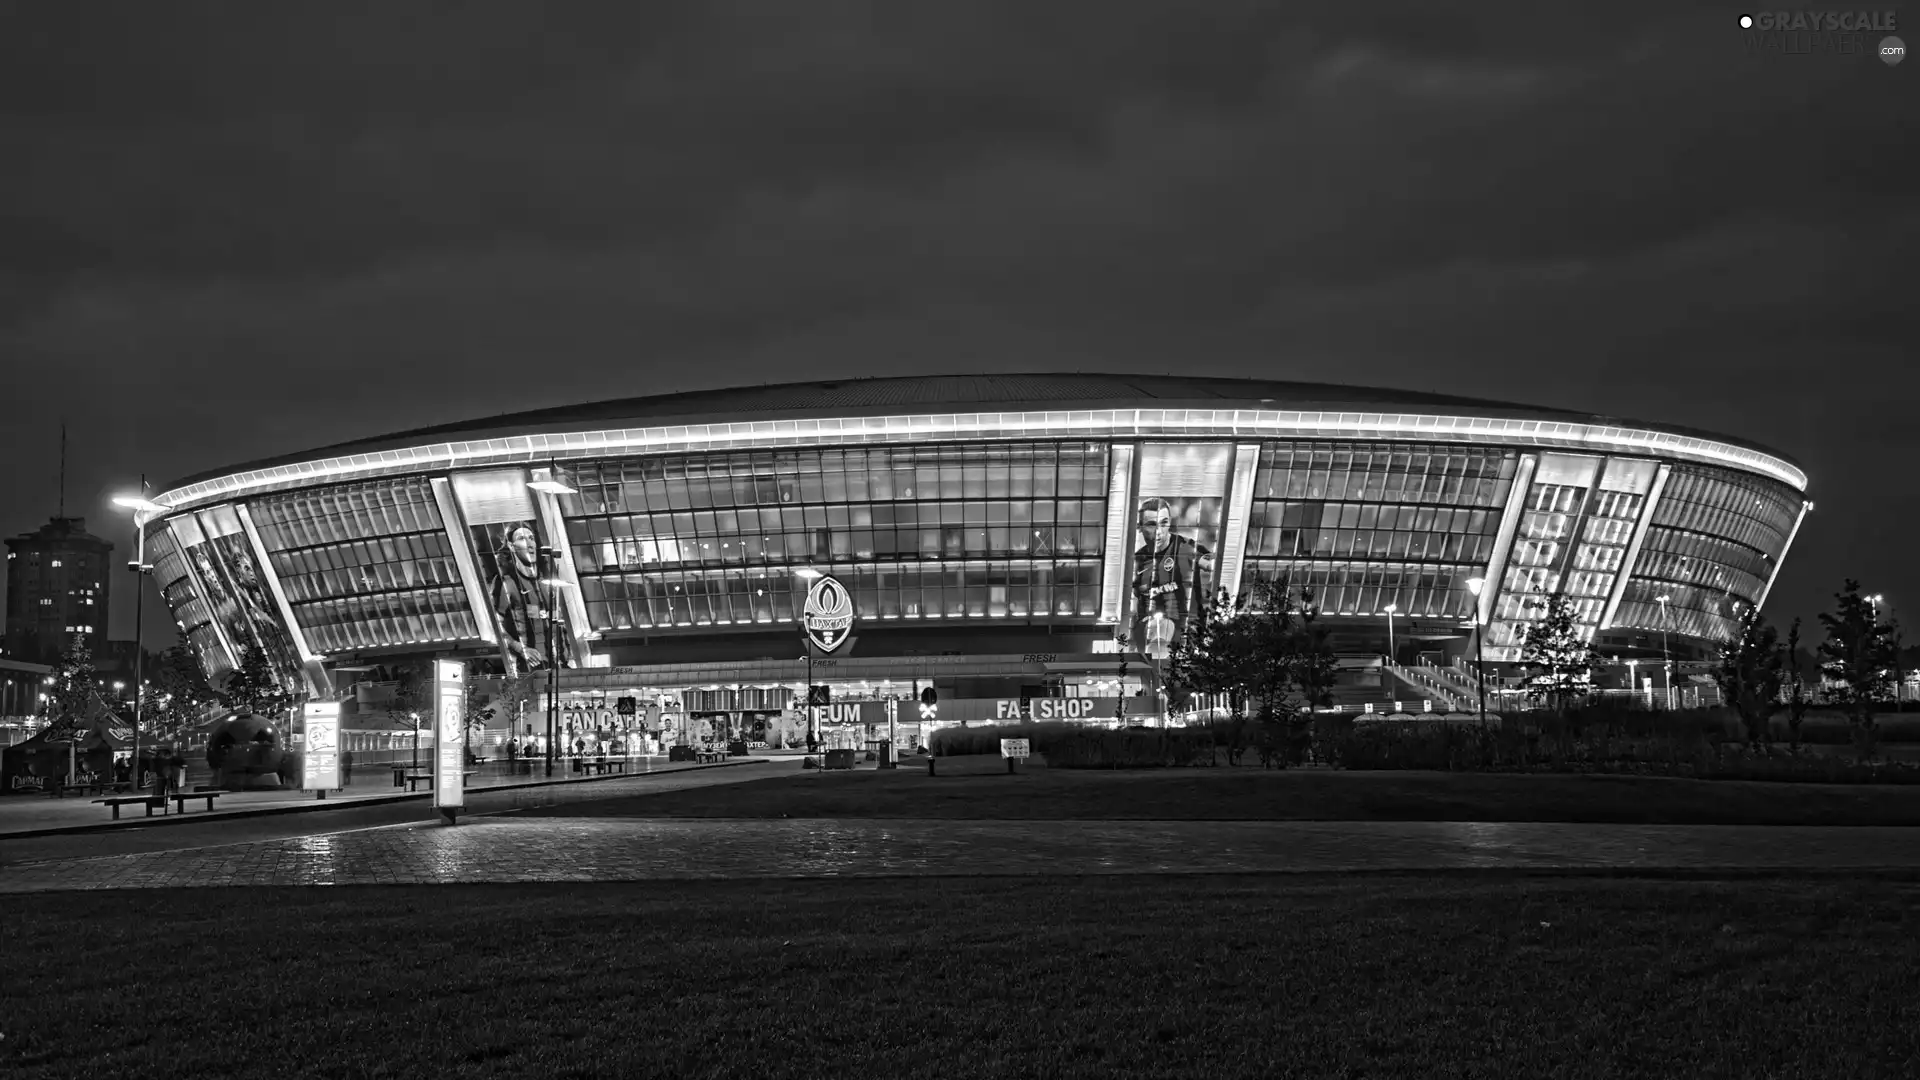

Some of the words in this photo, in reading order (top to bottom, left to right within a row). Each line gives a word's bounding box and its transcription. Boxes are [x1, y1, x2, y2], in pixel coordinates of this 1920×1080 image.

[1023, 654, 1056, 663] FRESH
[820, 703, 861, 723] EUM
[1040, 699, 1094, 718] SHOP
[563, 711, 596, 730] FAN
